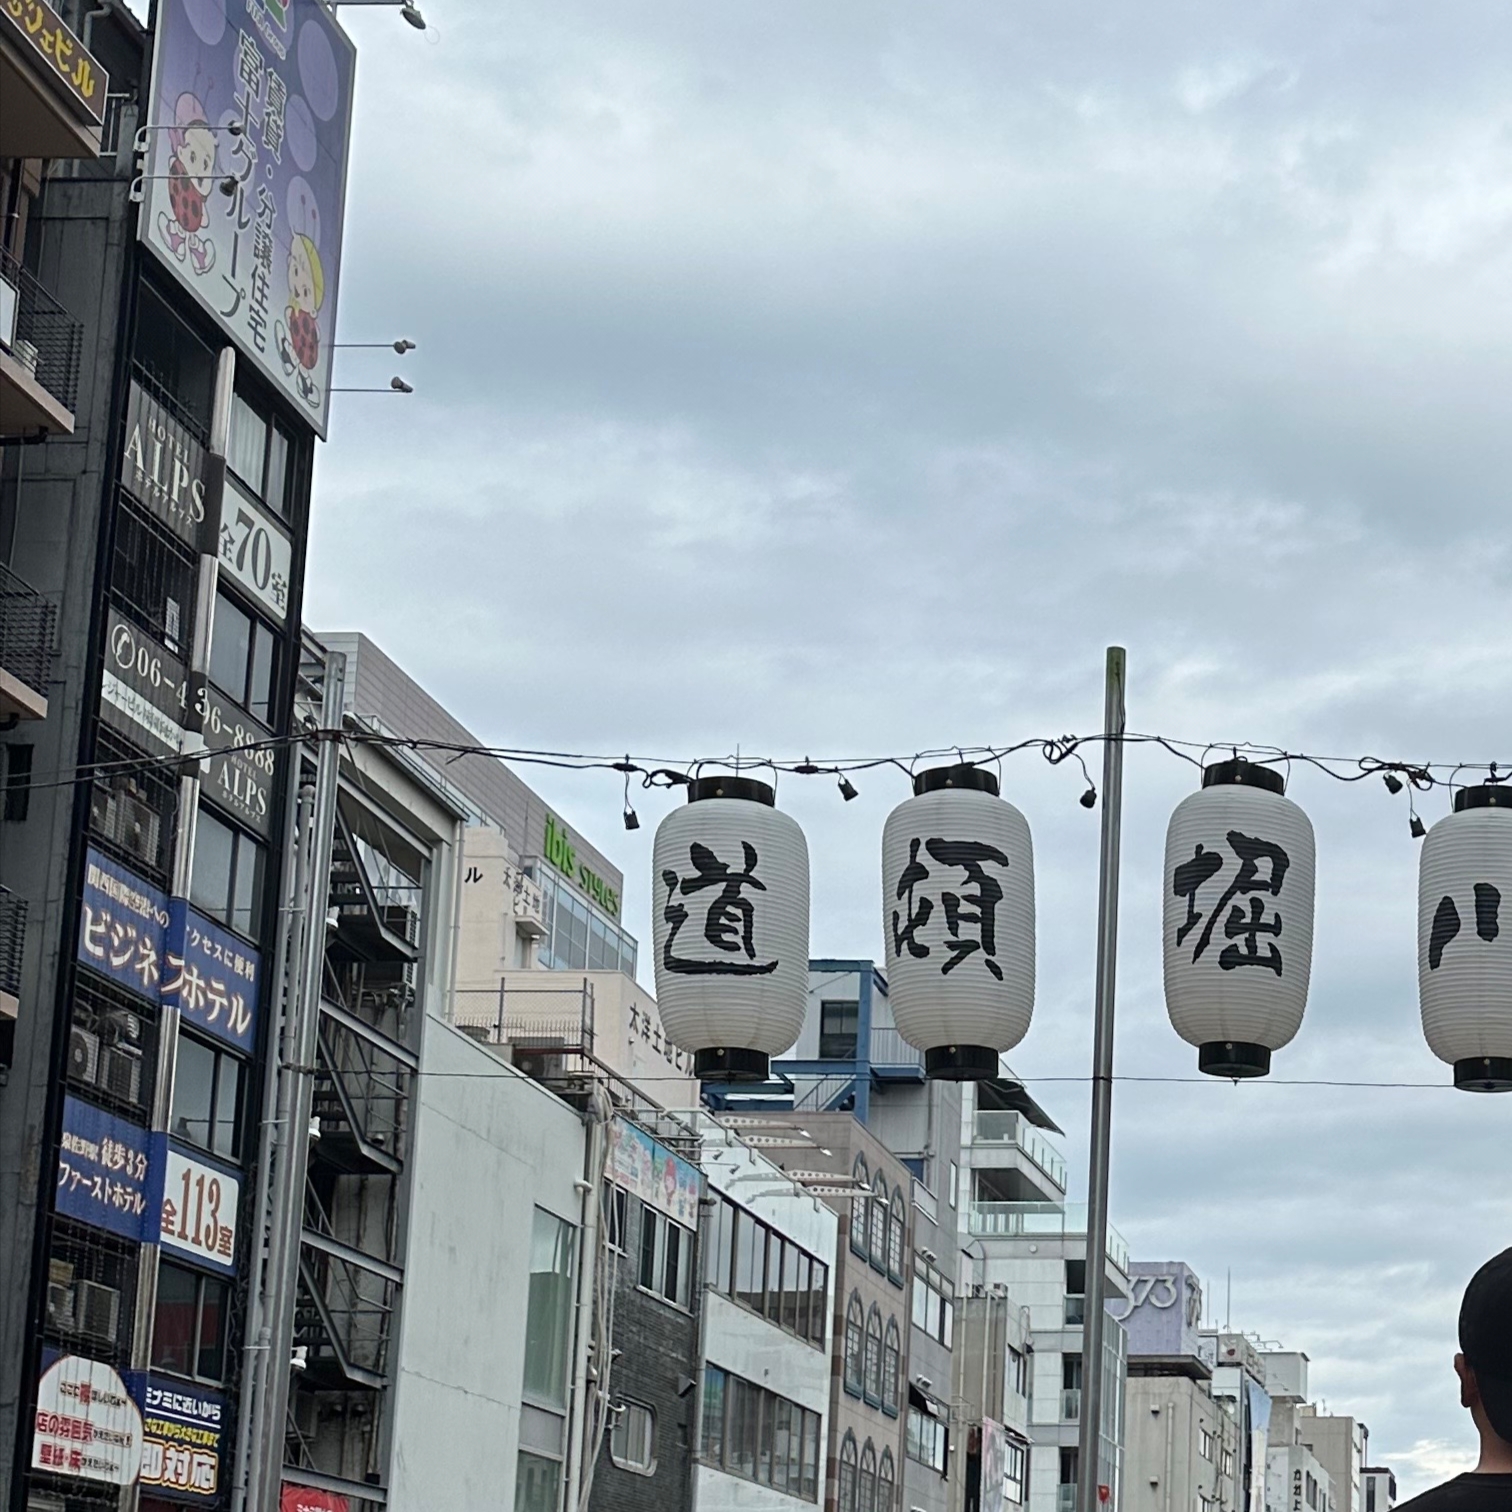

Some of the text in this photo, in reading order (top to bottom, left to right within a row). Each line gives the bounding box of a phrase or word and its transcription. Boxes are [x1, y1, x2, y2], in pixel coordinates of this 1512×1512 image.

[124, 423, 206, 523] ALPS
[149, 418, 189, 465] HOTEL
[218, 761, 267, 815] ALPS
[544, 813, 575, 879] ibis
[663, 840, 779, 976] 道
[893, 837, 1009, 981] 頓
[1173, 830, 1290, 976] 堀
[186, 924, 255, 982] クセスに便利
[161, 1168, 232, 1258] 全113室
